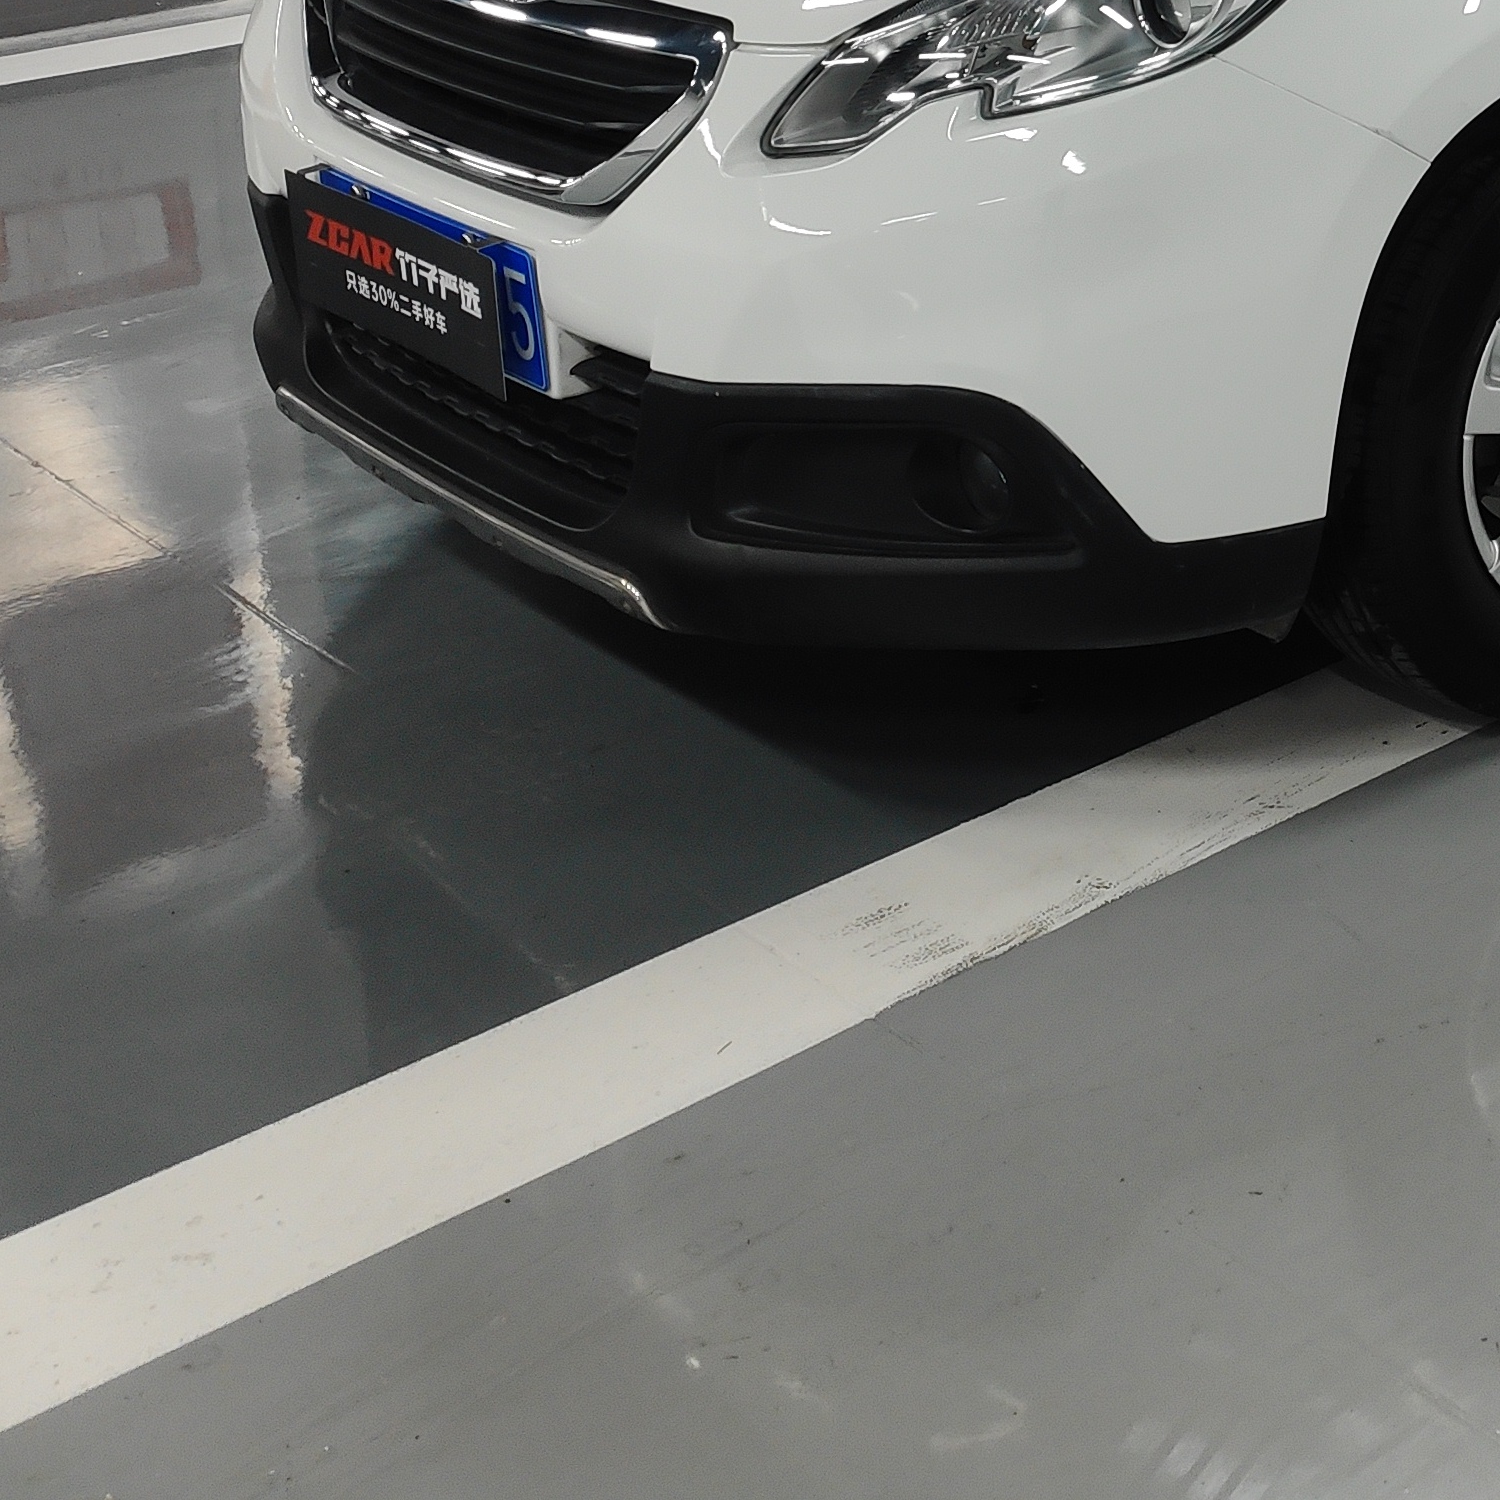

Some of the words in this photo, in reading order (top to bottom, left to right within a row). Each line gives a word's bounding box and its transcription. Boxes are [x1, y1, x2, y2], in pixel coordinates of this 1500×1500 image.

[305, 208, 394, 276] ZCAR
[345, 269, 448, 335] 只选30%二手好车
[503, 265, 536, 362] 5
